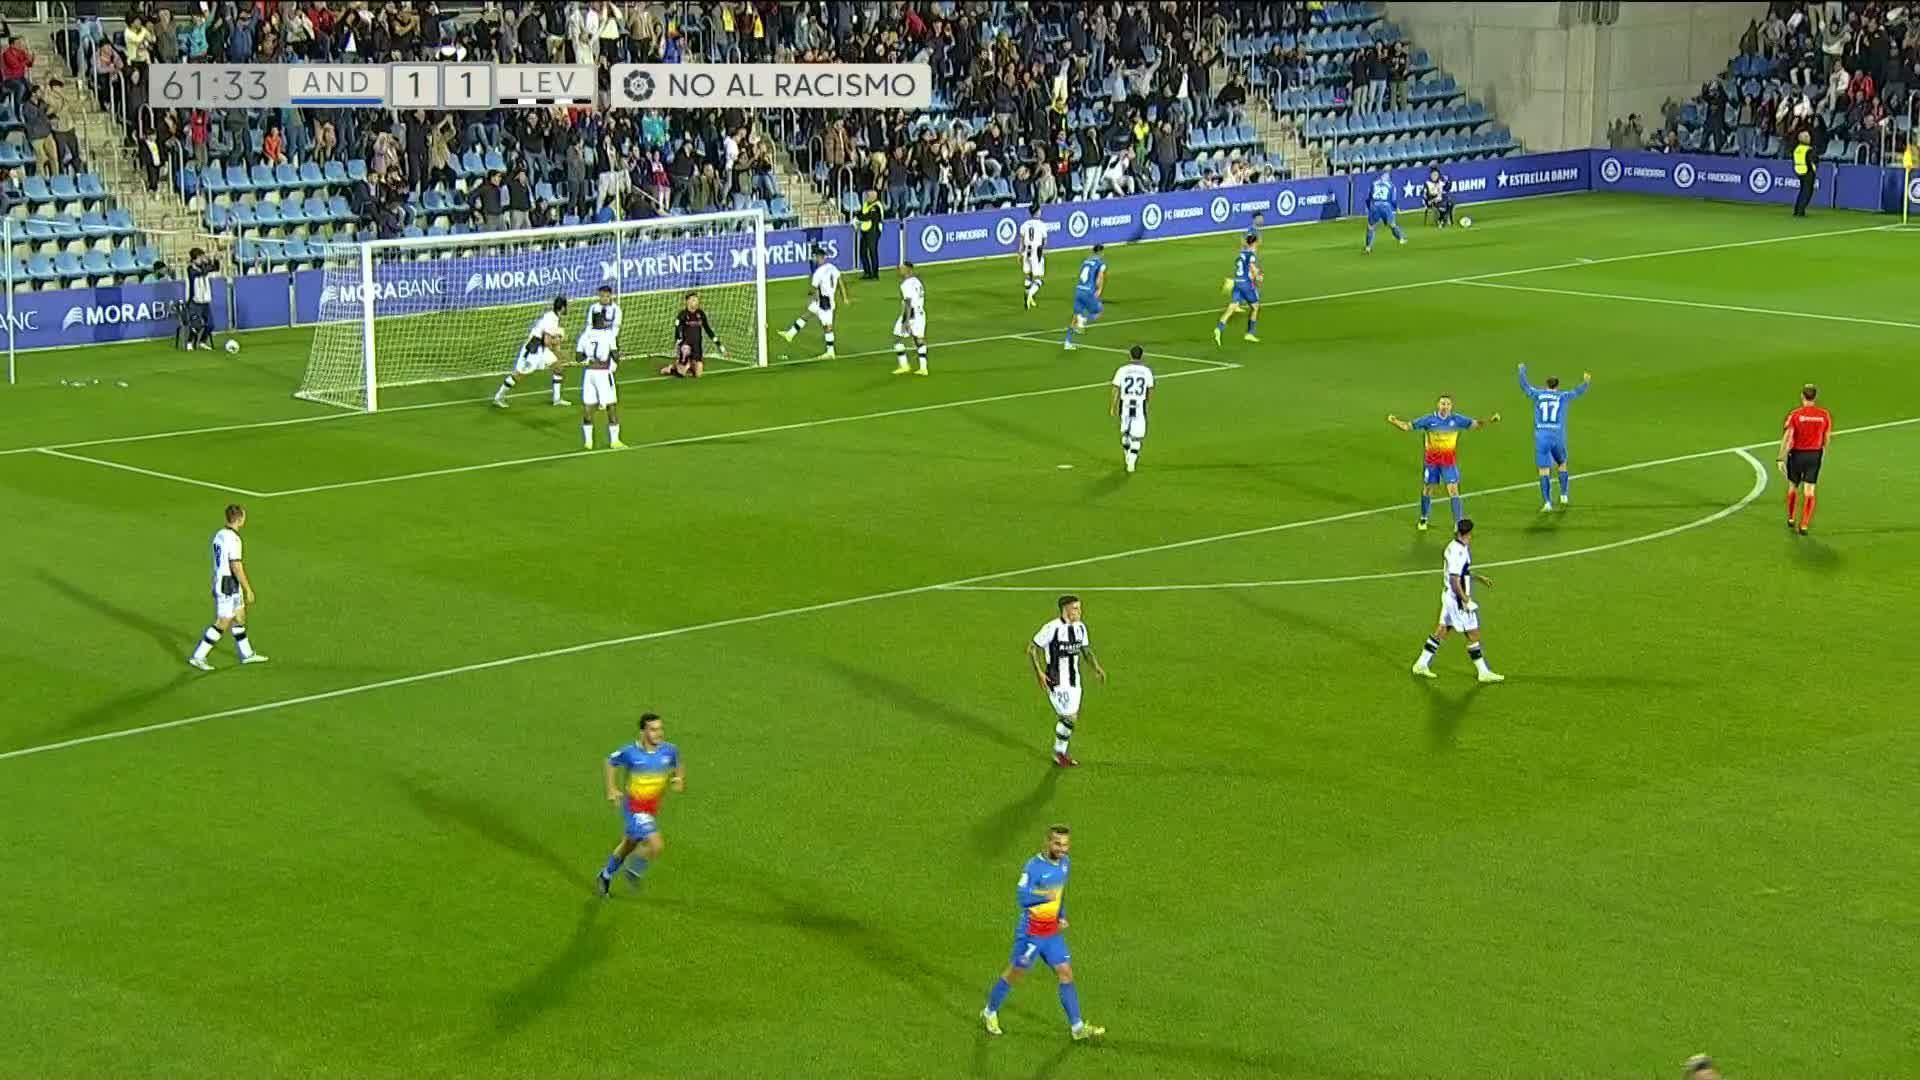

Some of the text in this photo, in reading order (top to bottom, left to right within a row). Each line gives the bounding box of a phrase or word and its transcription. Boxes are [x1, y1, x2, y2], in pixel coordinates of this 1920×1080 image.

[1510, 168, 1578, 186] ESTRELLA DAMM
[485, 265, 585, 290] MORABANC
[591, 341, 599, 360] 7
[1124, 376, 1146, 396] 23
[1538, 400, 1560, 422] 17
